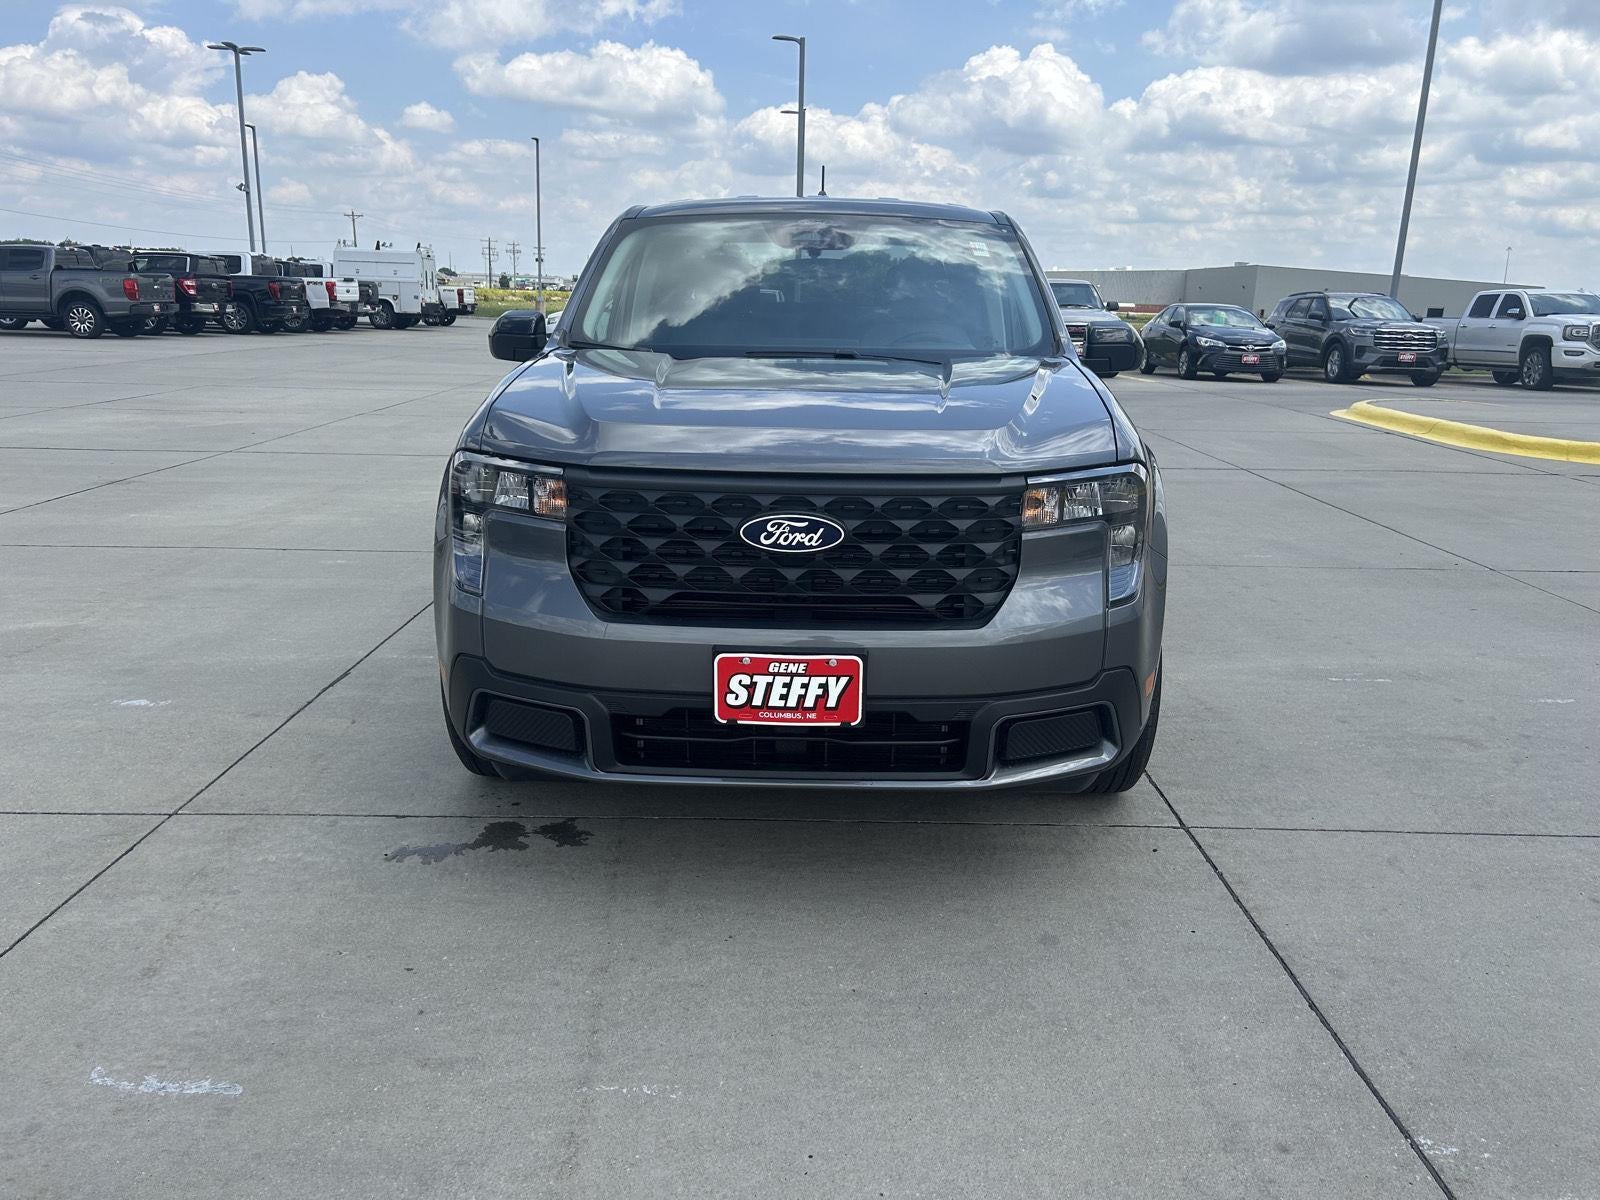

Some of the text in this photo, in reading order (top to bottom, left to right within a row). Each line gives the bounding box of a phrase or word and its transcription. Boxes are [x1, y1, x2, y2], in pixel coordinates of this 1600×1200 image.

[760, 520, 824, 546] Ford
[768, 662, 807, 674] GENE
[726, 674, 849, 708] STEFFY
[758, 711, 804, 719] COLUMBUS,
